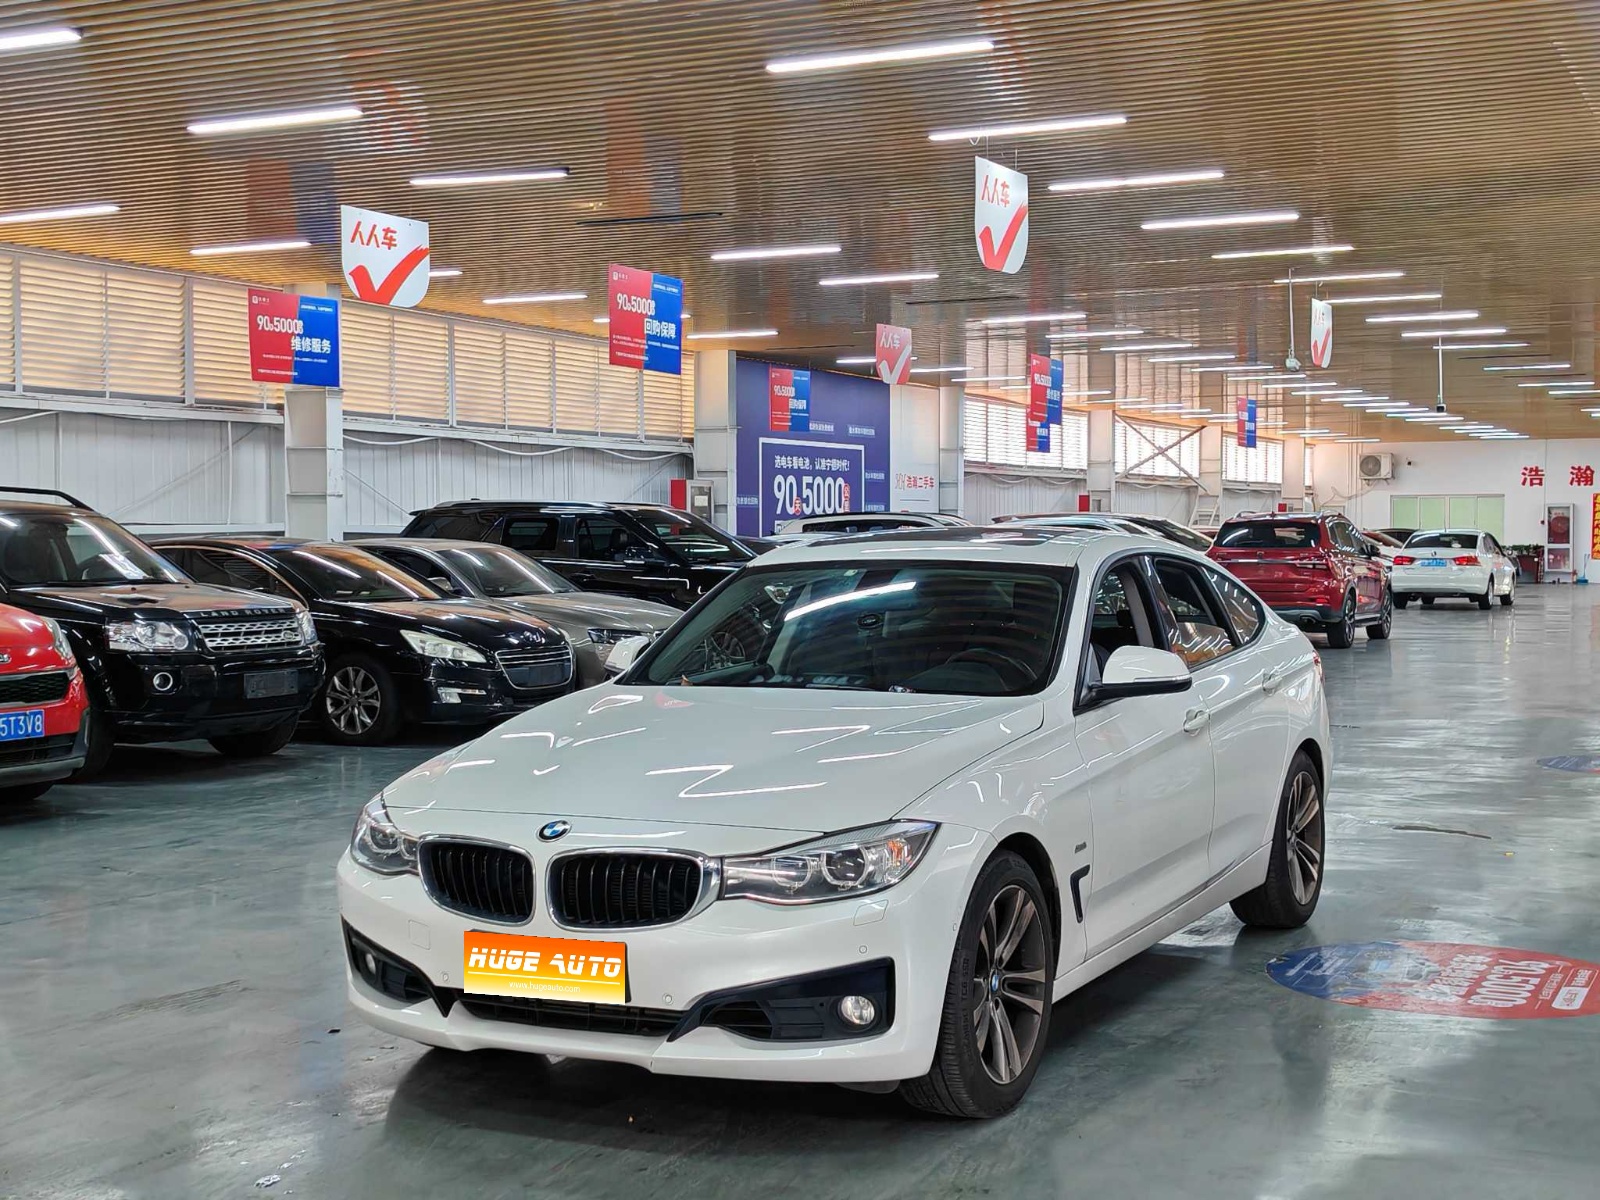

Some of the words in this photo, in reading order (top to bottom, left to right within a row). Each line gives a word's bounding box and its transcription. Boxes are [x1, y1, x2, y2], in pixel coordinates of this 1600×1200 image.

[981, 174, 1010, 208] 人人车
[350, 221, 397, 250] 人人车
[644, 318, 676, 339] 回购保障
[291, 335, 331, 353] 维修服务
[880, 331, 901, 350] 人人车
[1521, 465, 1595, 488] 浩瀚
[200, 610, 239, 618] LAND
[244, 608, 286, 616] ROVER
[0, 715, 42, 736] 5T3V8
